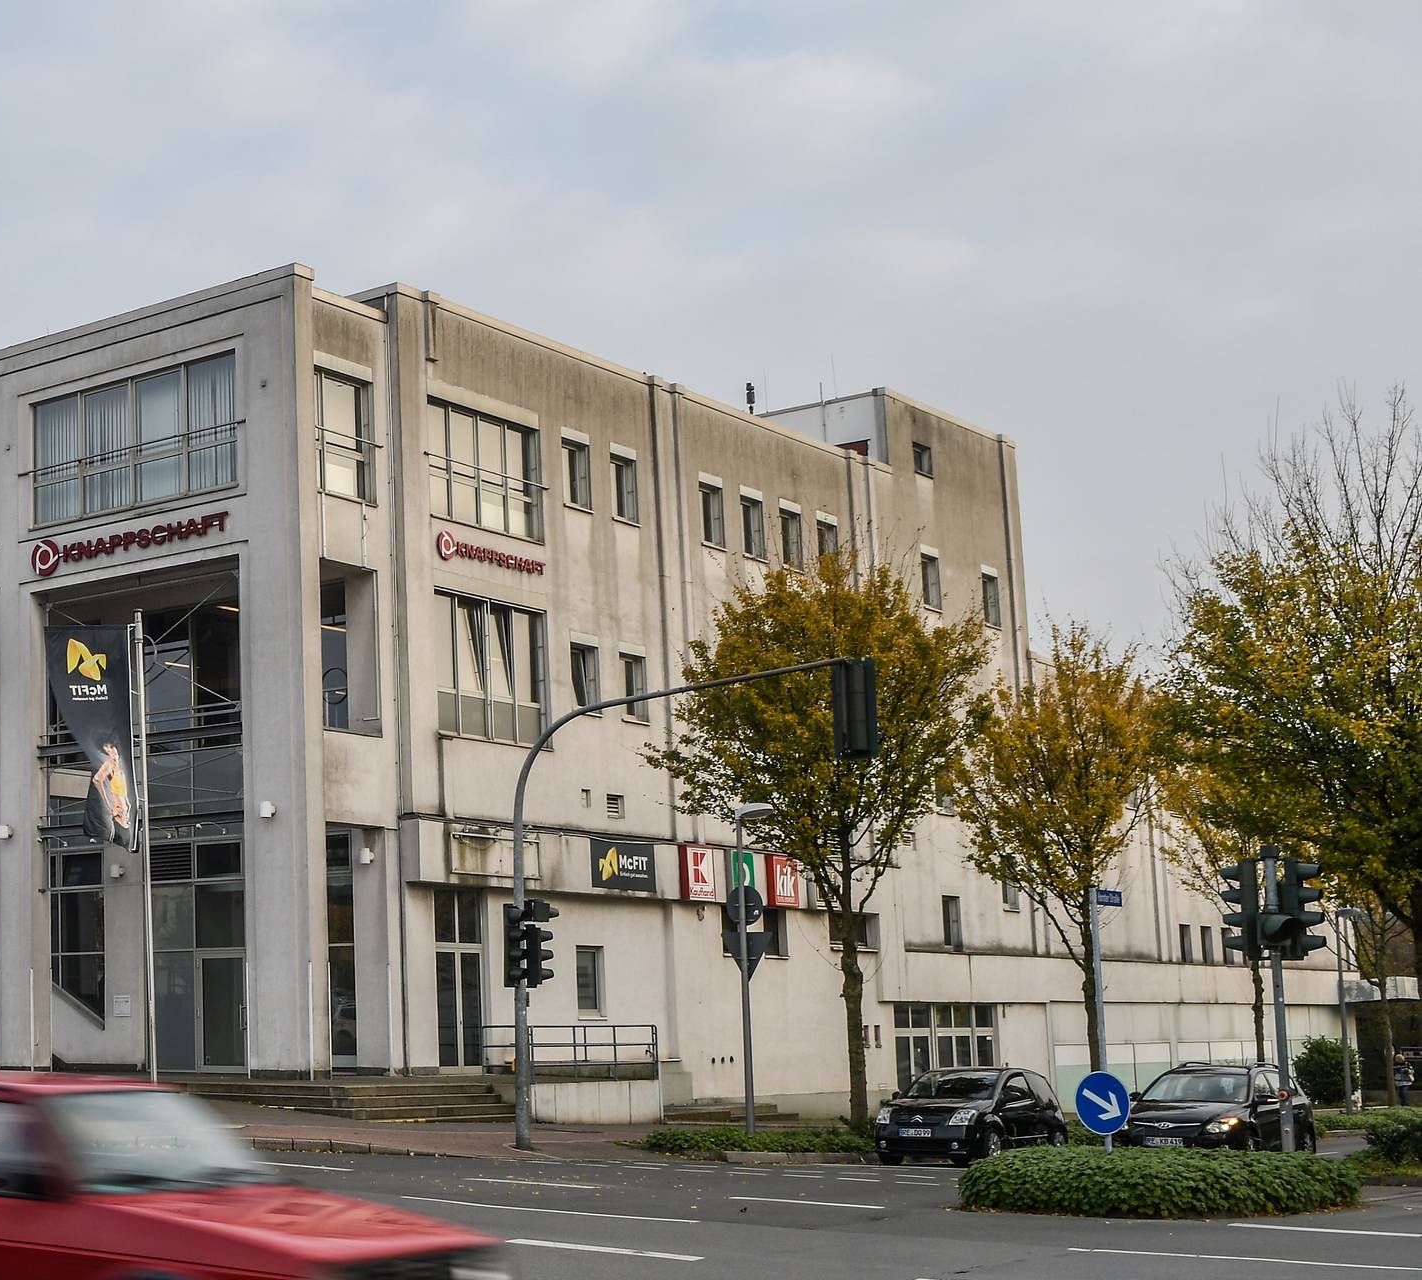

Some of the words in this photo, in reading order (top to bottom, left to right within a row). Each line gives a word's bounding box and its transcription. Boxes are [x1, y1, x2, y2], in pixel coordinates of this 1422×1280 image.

[63, 511, 229, 563] KNAPPSCHAFT
[456, 541, 546, 576] KNAPPSCHAFT
[619, 854, 648, 871] McFIT
[689, 887, 715, 897] Kaufland
